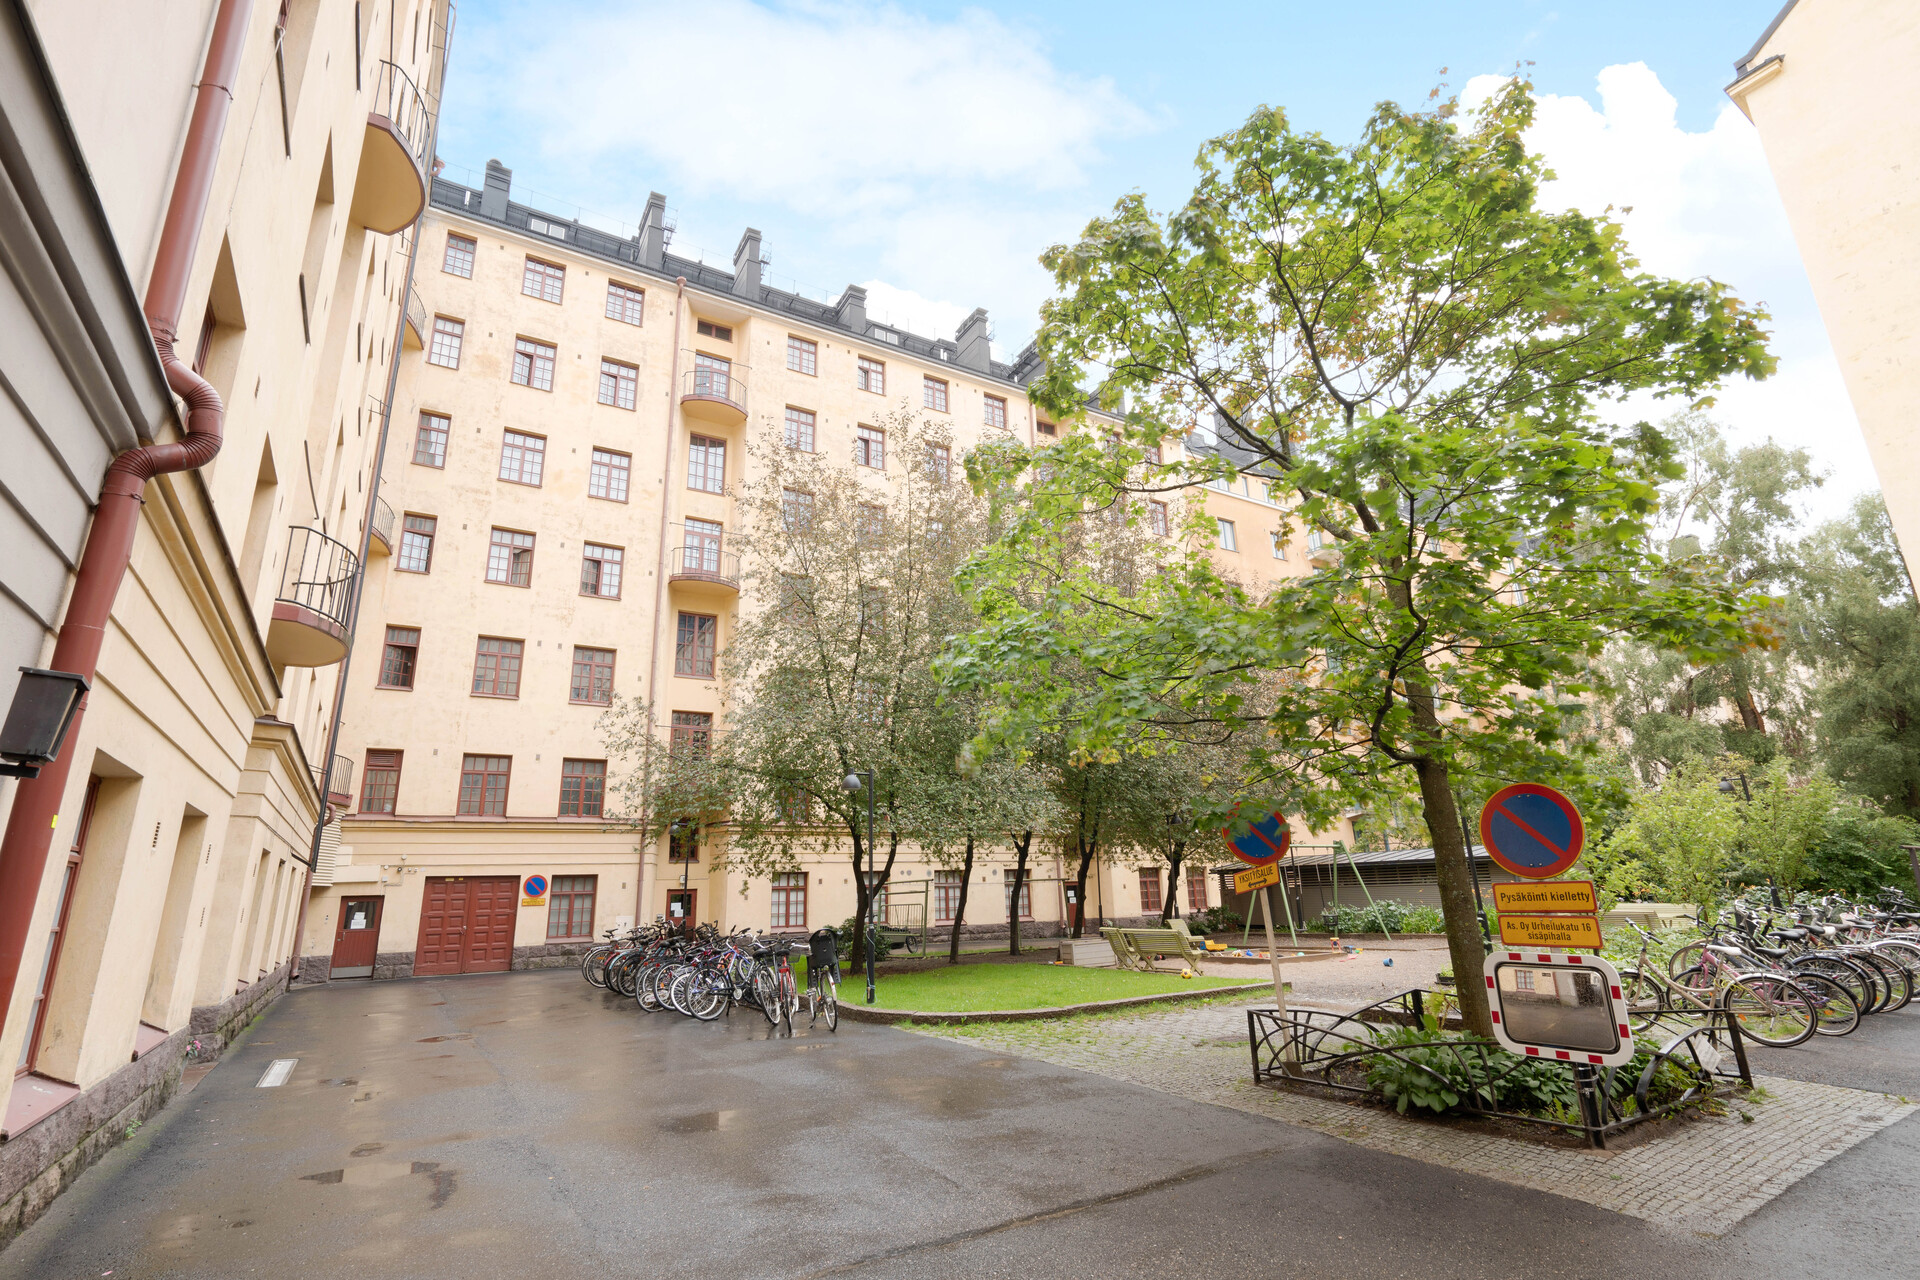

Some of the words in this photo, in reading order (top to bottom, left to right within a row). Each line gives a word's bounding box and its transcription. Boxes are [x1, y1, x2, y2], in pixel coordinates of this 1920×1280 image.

[1500, 891, 1548, 903] Pysäköinti
[1550, 891, 1590, 903] kielletty
[1506, 921, 1518, 930] As.
[1520, 921, 1530, 931] Oy
[1531, 921, 1579, 931] Urheilukatu
[1581, 922, 1592, 932] 16
[1527, 932, 1572, 941] sisäpihalla
